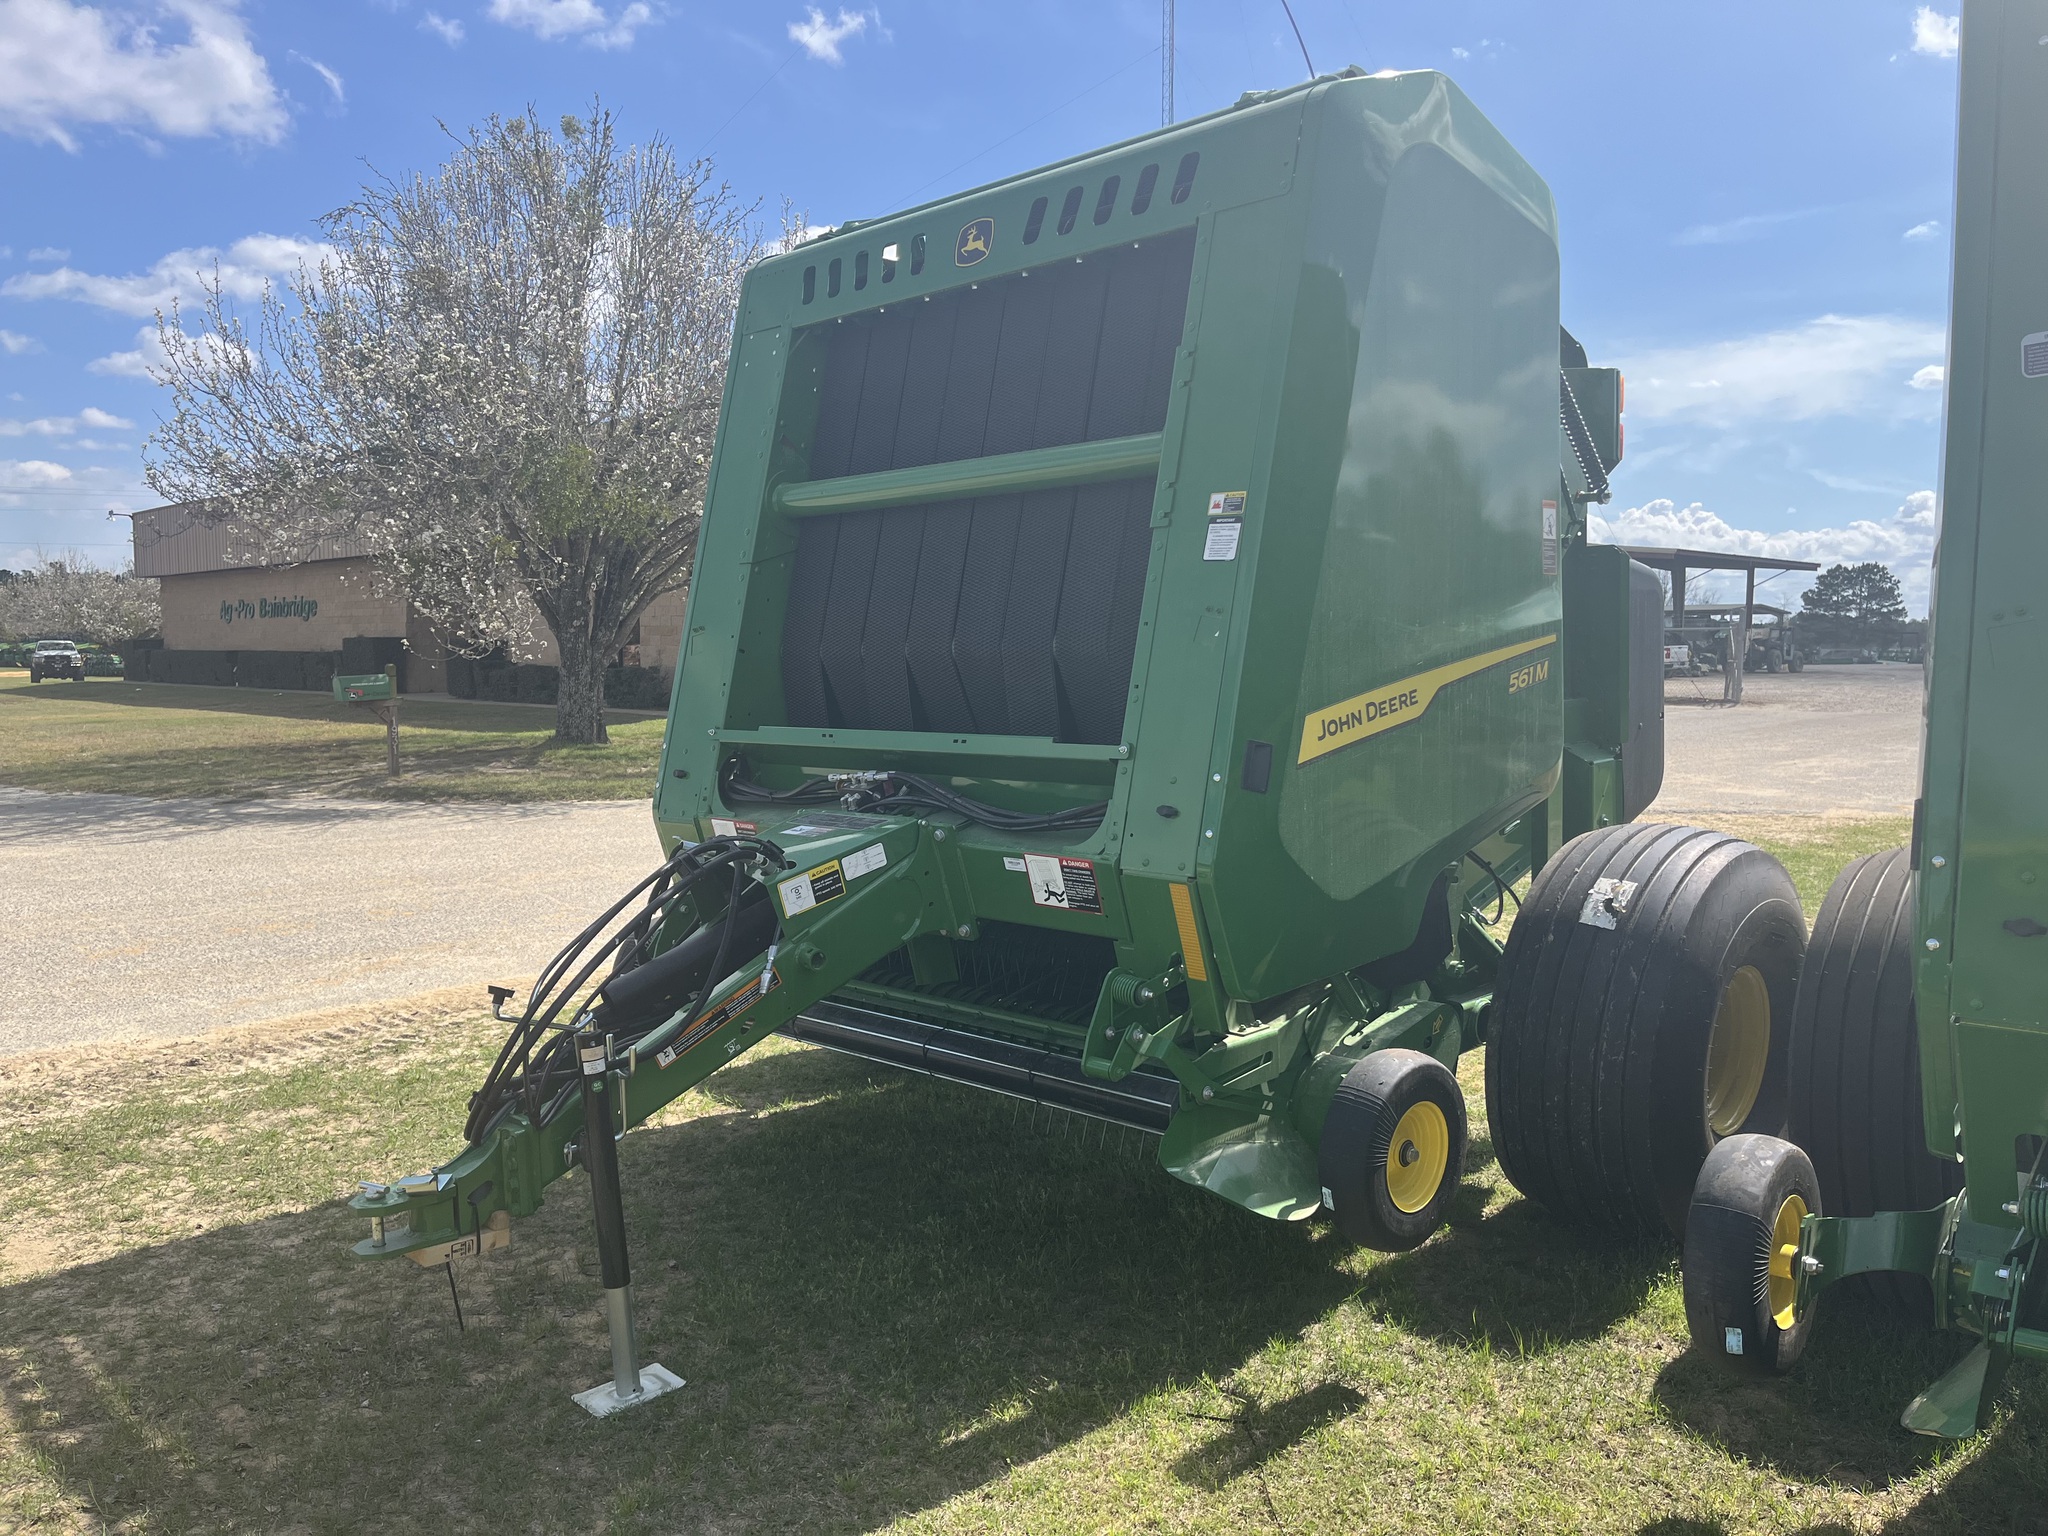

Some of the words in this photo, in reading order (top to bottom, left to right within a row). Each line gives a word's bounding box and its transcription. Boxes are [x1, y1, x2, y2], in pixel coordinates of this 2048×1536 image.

[220, 599, 255, 624] Ag-Pro
[259, 595, 318, 622] Bainbridge
[1508, 660, 1549, 695] 561M
[1317, 709, 1363, 742] JOHN
[1365, 688, 1419, 722] DEERE
[815, 865, 836, 876] CAUTION
[1067, 860, 1090, 868] DANGER
